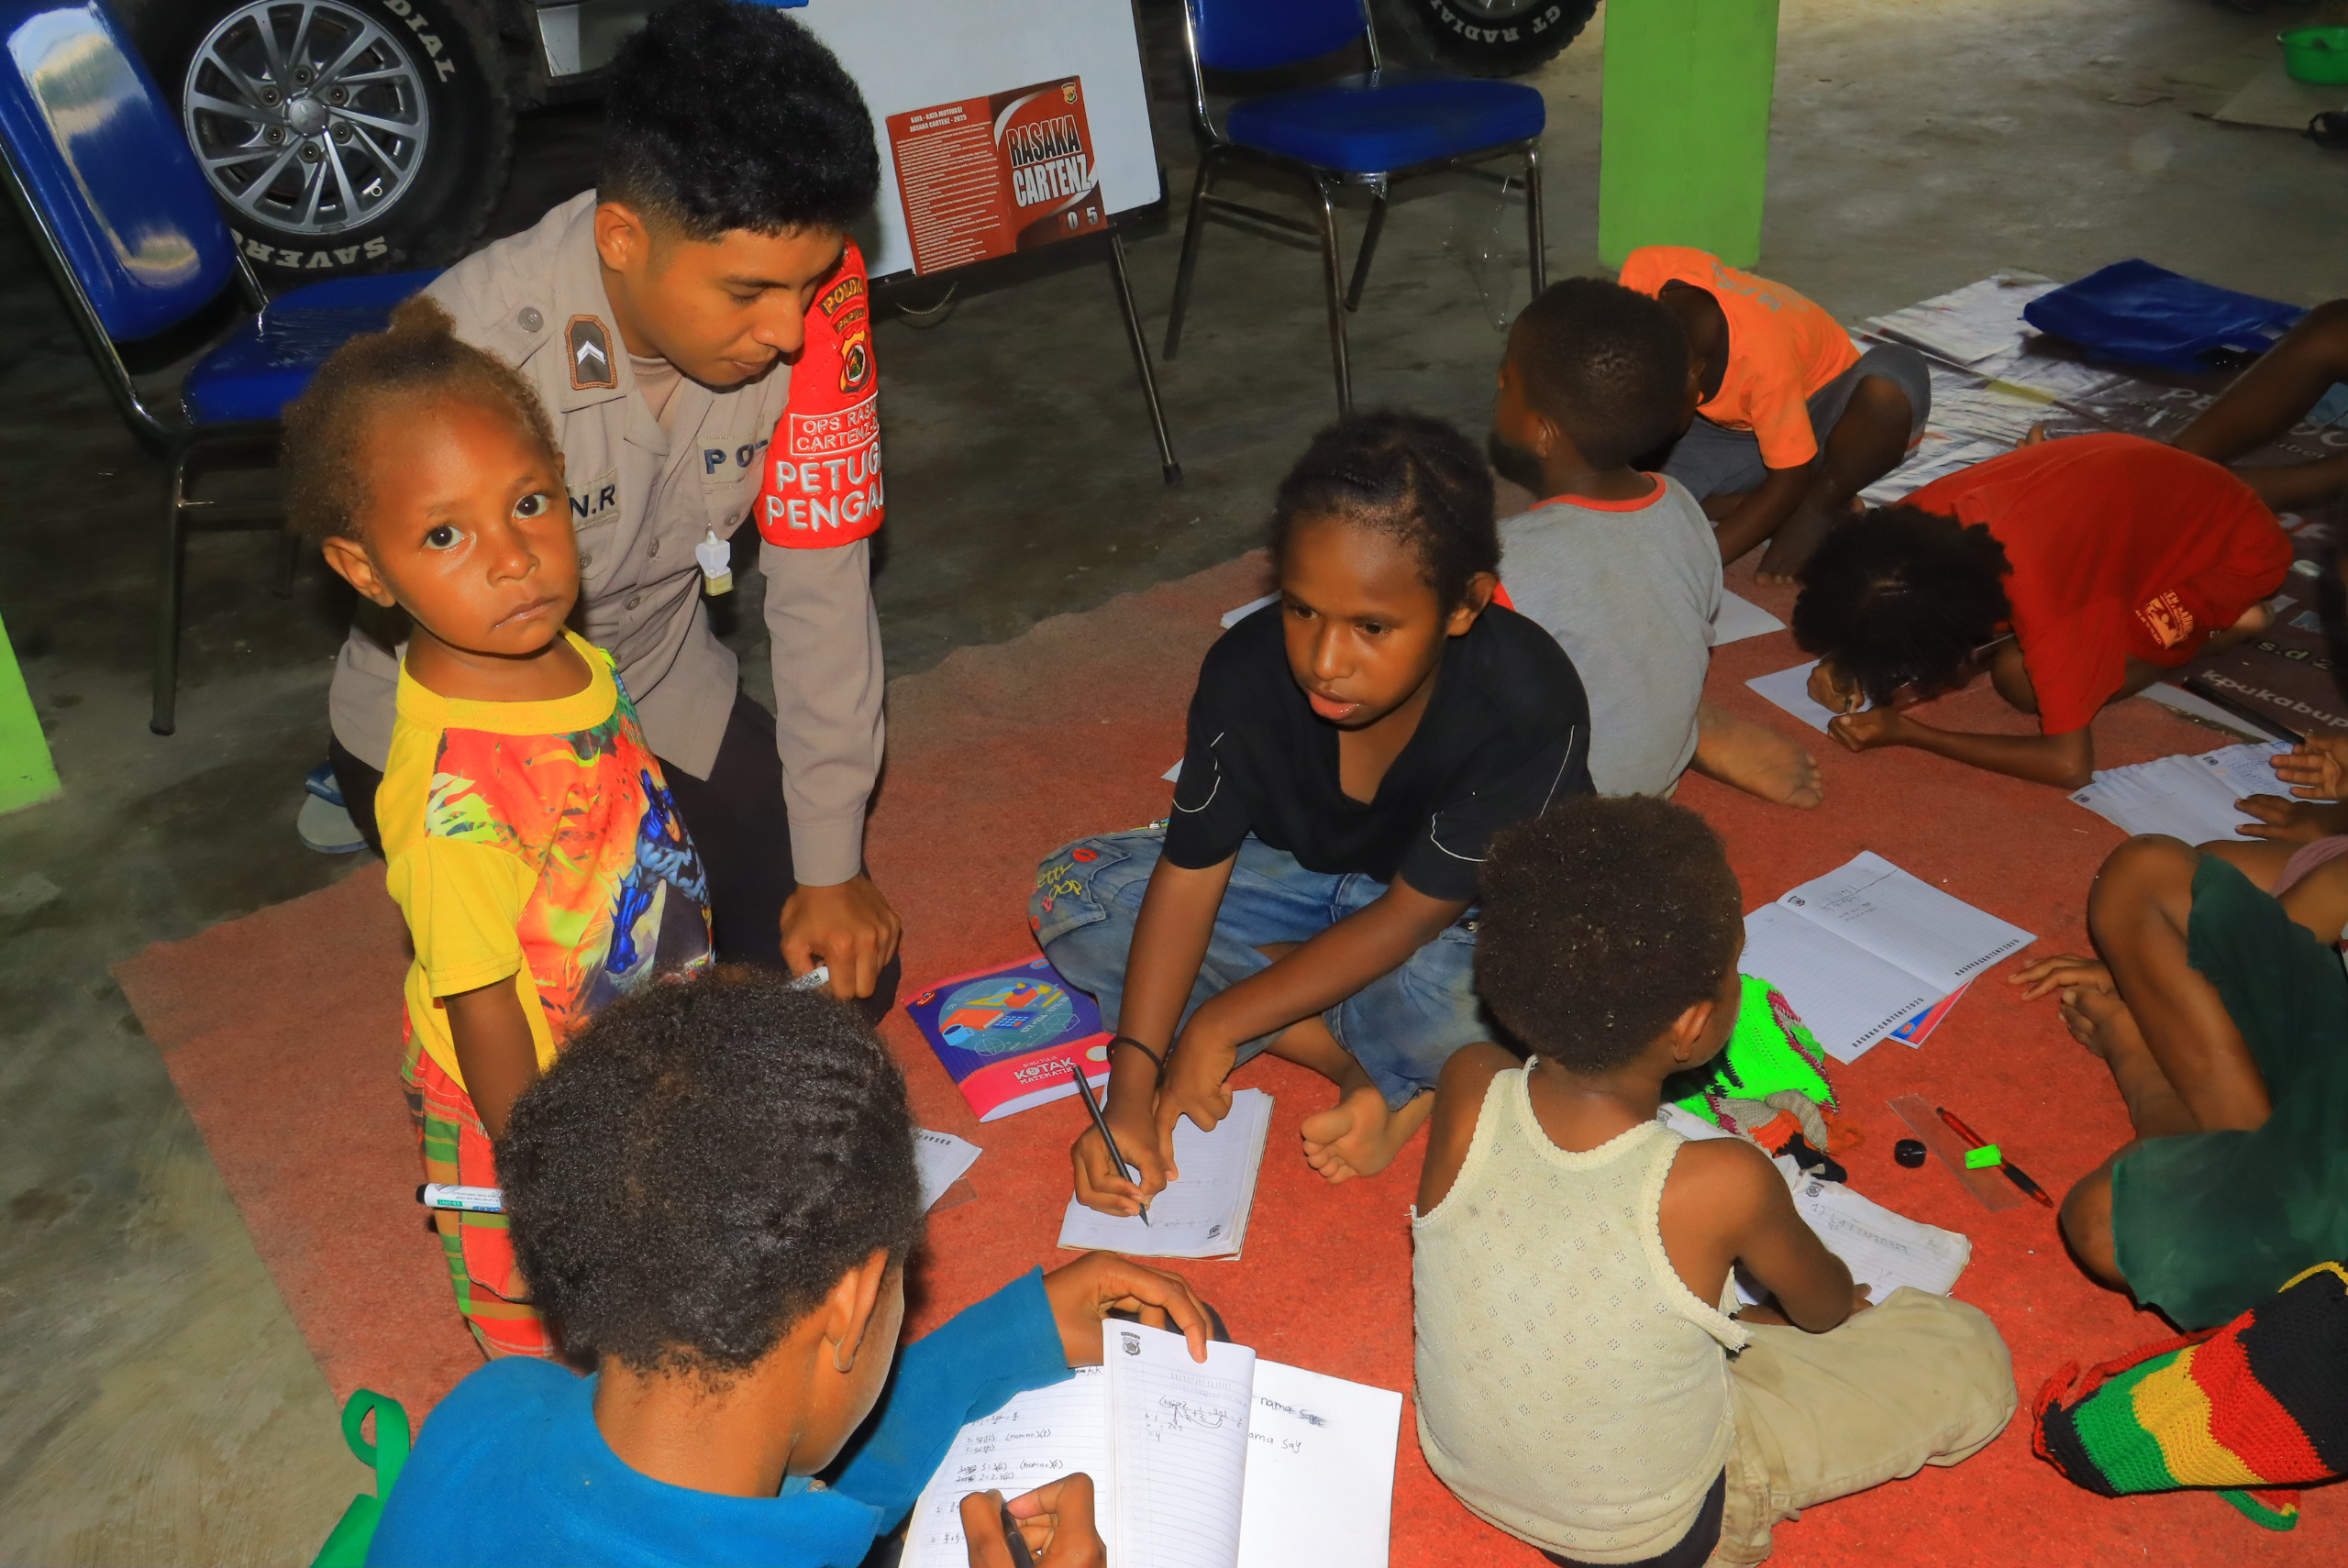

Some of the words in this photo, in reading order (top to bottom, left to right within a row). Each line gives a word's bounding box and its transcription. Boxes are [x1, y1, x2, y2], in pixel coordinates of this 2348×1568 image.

[1533, 6, 1561, 34] GT
[909, 122, 929, 133] RASAKA
[929, 117, 951, 128] CARTENZ
[910, 115, 924, 124] KATA
[925, 111, 938, 120] KATA
[938, 106, 963, 118] MOTIVASI
[1005, 115, 1082, 168] RASAKA
[1012, 154, 1092, 207] CARTENZ
[803, 416, 840, 434] OPS
[776, 441, 880, 492] PETUG
[1852, 1028, 1879, 1048] RASAKA
[1877, 1008, 1907, 1030] CARTENZ
[1905, 997, 1924, 1010] 2025
[1013, 1056, 1076, 1080] KOTAK
[1260, 1397, 1293, 1414] nama
